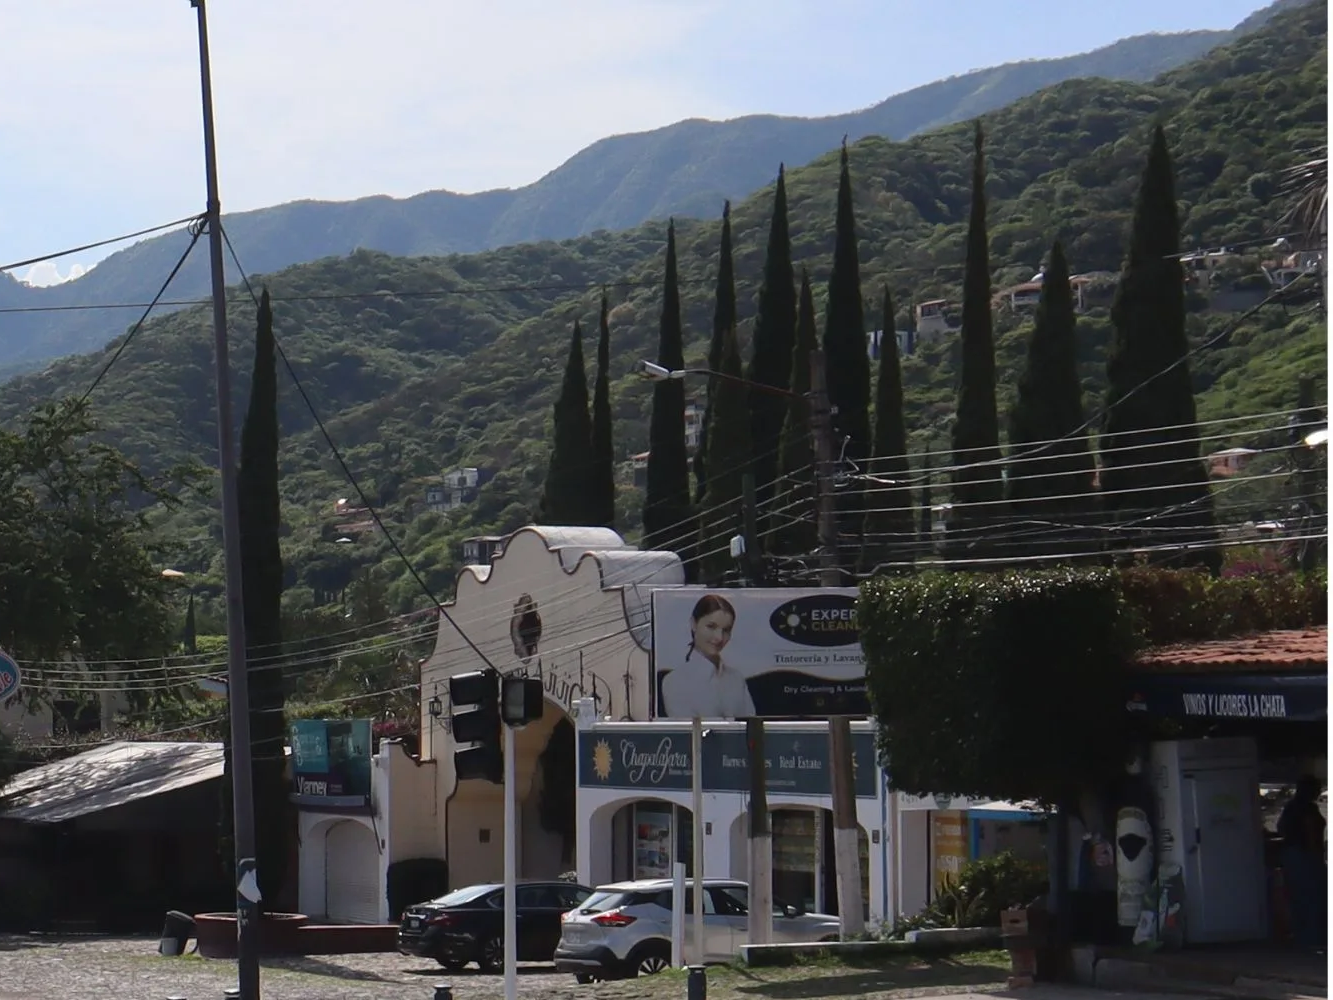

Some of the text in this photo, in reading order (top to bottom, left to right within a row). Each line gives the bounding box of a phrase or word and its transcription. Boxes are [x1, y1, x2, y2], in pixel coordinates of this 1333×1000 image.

[784, 685, 798, 694] Dry
[1183, 693, 1286, 717] VINOS Y LICORES LA CHATA
[779, 755, 796, 769] Real
[797, 755, 821, 770] Estate
